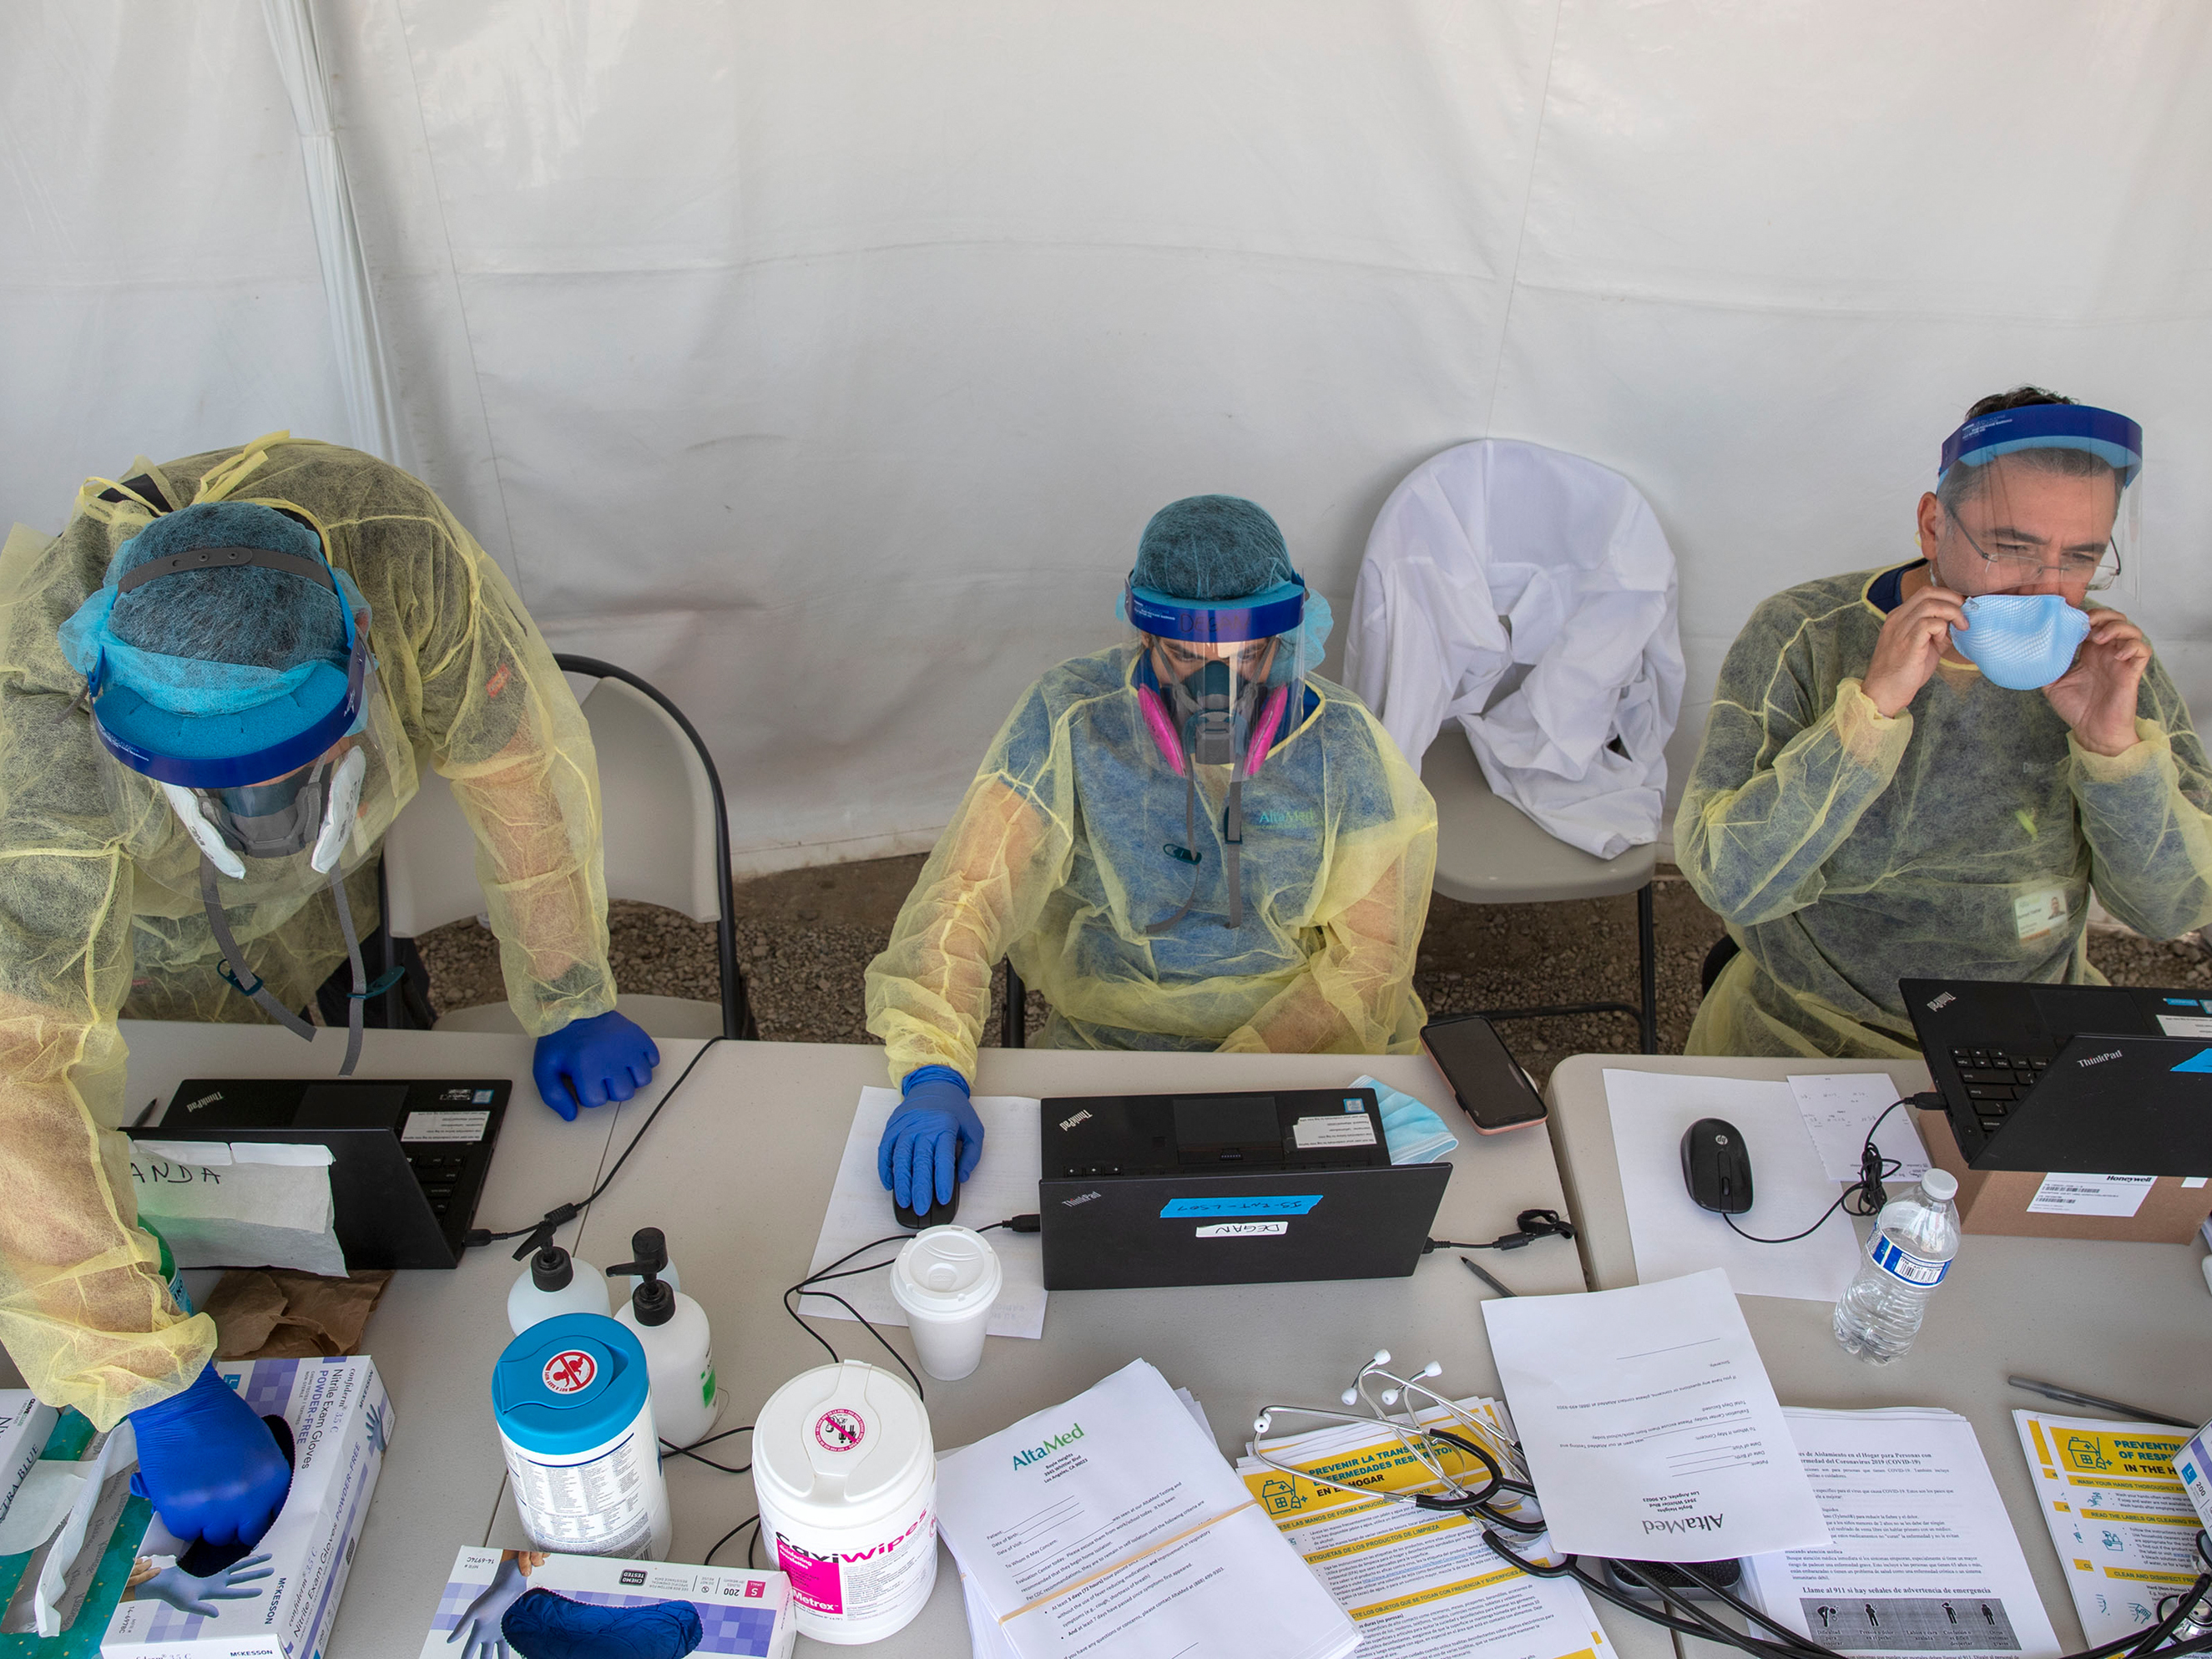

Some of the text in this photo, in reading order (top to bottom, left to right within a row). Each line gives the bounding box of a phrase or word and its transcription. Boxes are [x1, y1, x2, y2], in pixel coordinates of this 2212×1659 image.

[1927, 991, 1956, 1013] ThinkPad
[2077, 1050, 2124, 1069] ThinkPad
[187, 1090, 225, 1113] ThinkPad
[1058, 1109, 1093, 1132] ThinkPad
[130, 1161, 222, 1185] ANDA
[2106, 1175, 2153, 1183] Honeywell
[1062, 1191, 1102, 1207] ThinkPad
[1214, 1223, 1279, 1234] DEGAN
[295, 1368, 329, 1448] POWDER-FREE
[300, 1368, 344, 1470] Nitrile Exam Gloves
[1010, 1421, 1085, 1471] AltaMed
[2114, 1439, 2180, 1454] PREVENTIN
[2119, 1449, 2134, 1459] OF
[15, 1443, 42, 1479] BLUE
[1045, 1452, 1073, 1469] Boyle Heights
[1053, 1459, 1072, 1471] Whittier
[1071, 1454, 1082, 1463] Blvd
[1308, 1454, 1375, 1477] PREVENIR LA
[2124, 1463, 2166, 1474] IN THE
[335, 1442, 361, 1521] POWDER-FREE
[1051, 1468, 1070, 1480] Angeles,
[1316, 1473, 1385, 1497] EN HOGAR
[2134, 1483, 2175, 1493] THOROUGHLY
[2196, 1482, 2206, 1496] 200
[1120, 1510, 1130, 1518] seen
[1142, 1493, 1160, 1506] AltaMed
[1159, 1485, 1175, 1496] Testing
[1661, 1499, 1684, 1508] Whittier
[1667, 1491, 1689, 1500] Angeles,
[1291, 1520, 1304, 1528] LAS
[1304, 1515, 1326, 1525] MANOS
[1336, 1506, 1358, 1516] FORMA
[1358, 1499, 1386, 1510] MINUCIOS
[2155, 1516, 2187, 1525] CLEANING
[1641, 1510, 1725, 1538] AltaMed
[991, 1540, 1002, 1548] Date
[1015, 1571, 1038, 1585] Evaluation
[1037, 1563, 1052, 1575] Center
[1065, 1548, 1080, 1558] Please
[1080, 1540, 1095, 1550] excuse
[1093, 1533, 1106, 1543] them
[1104, 1528, 1117, 1536] from
[1115, 1515, 1140, 1530] work/school
[1164, 1495, 1175, 1504] been
[1308, 1550, 1342, 1562] ETIQUETAS
[1351, 1543, 1366, 1551] LOS
[1365, 1533, 1403, 1548] PRODUCTOS
[1412, 1523, 1440, 1535] LIMPIEZA
[997, 1548, 1008, 1556] Date
[1010, 1555, 1027, 1566] Whom
[1028, 1548, 1040, 1556] May
[294, 1521, 338, 1638] Nitrile Exam Gloves
[2149, 1574, 2182, 1582] DISINFECT
[723, 1587, 740, 1596] 200
[750, 1587, 758, 1596] S
[1362, 1608, 1375, 1616] LOS
[1374, 1601, 1400, 1613] OBJETOS
[1419, 1591, 1438, 1601] TOCAN
[1485, 1570, 1518, 1583] SUPERFICIES
[1854, 1586, 1866, 1595] hay
[1952, 1586, 1992, 1596] emergencia
